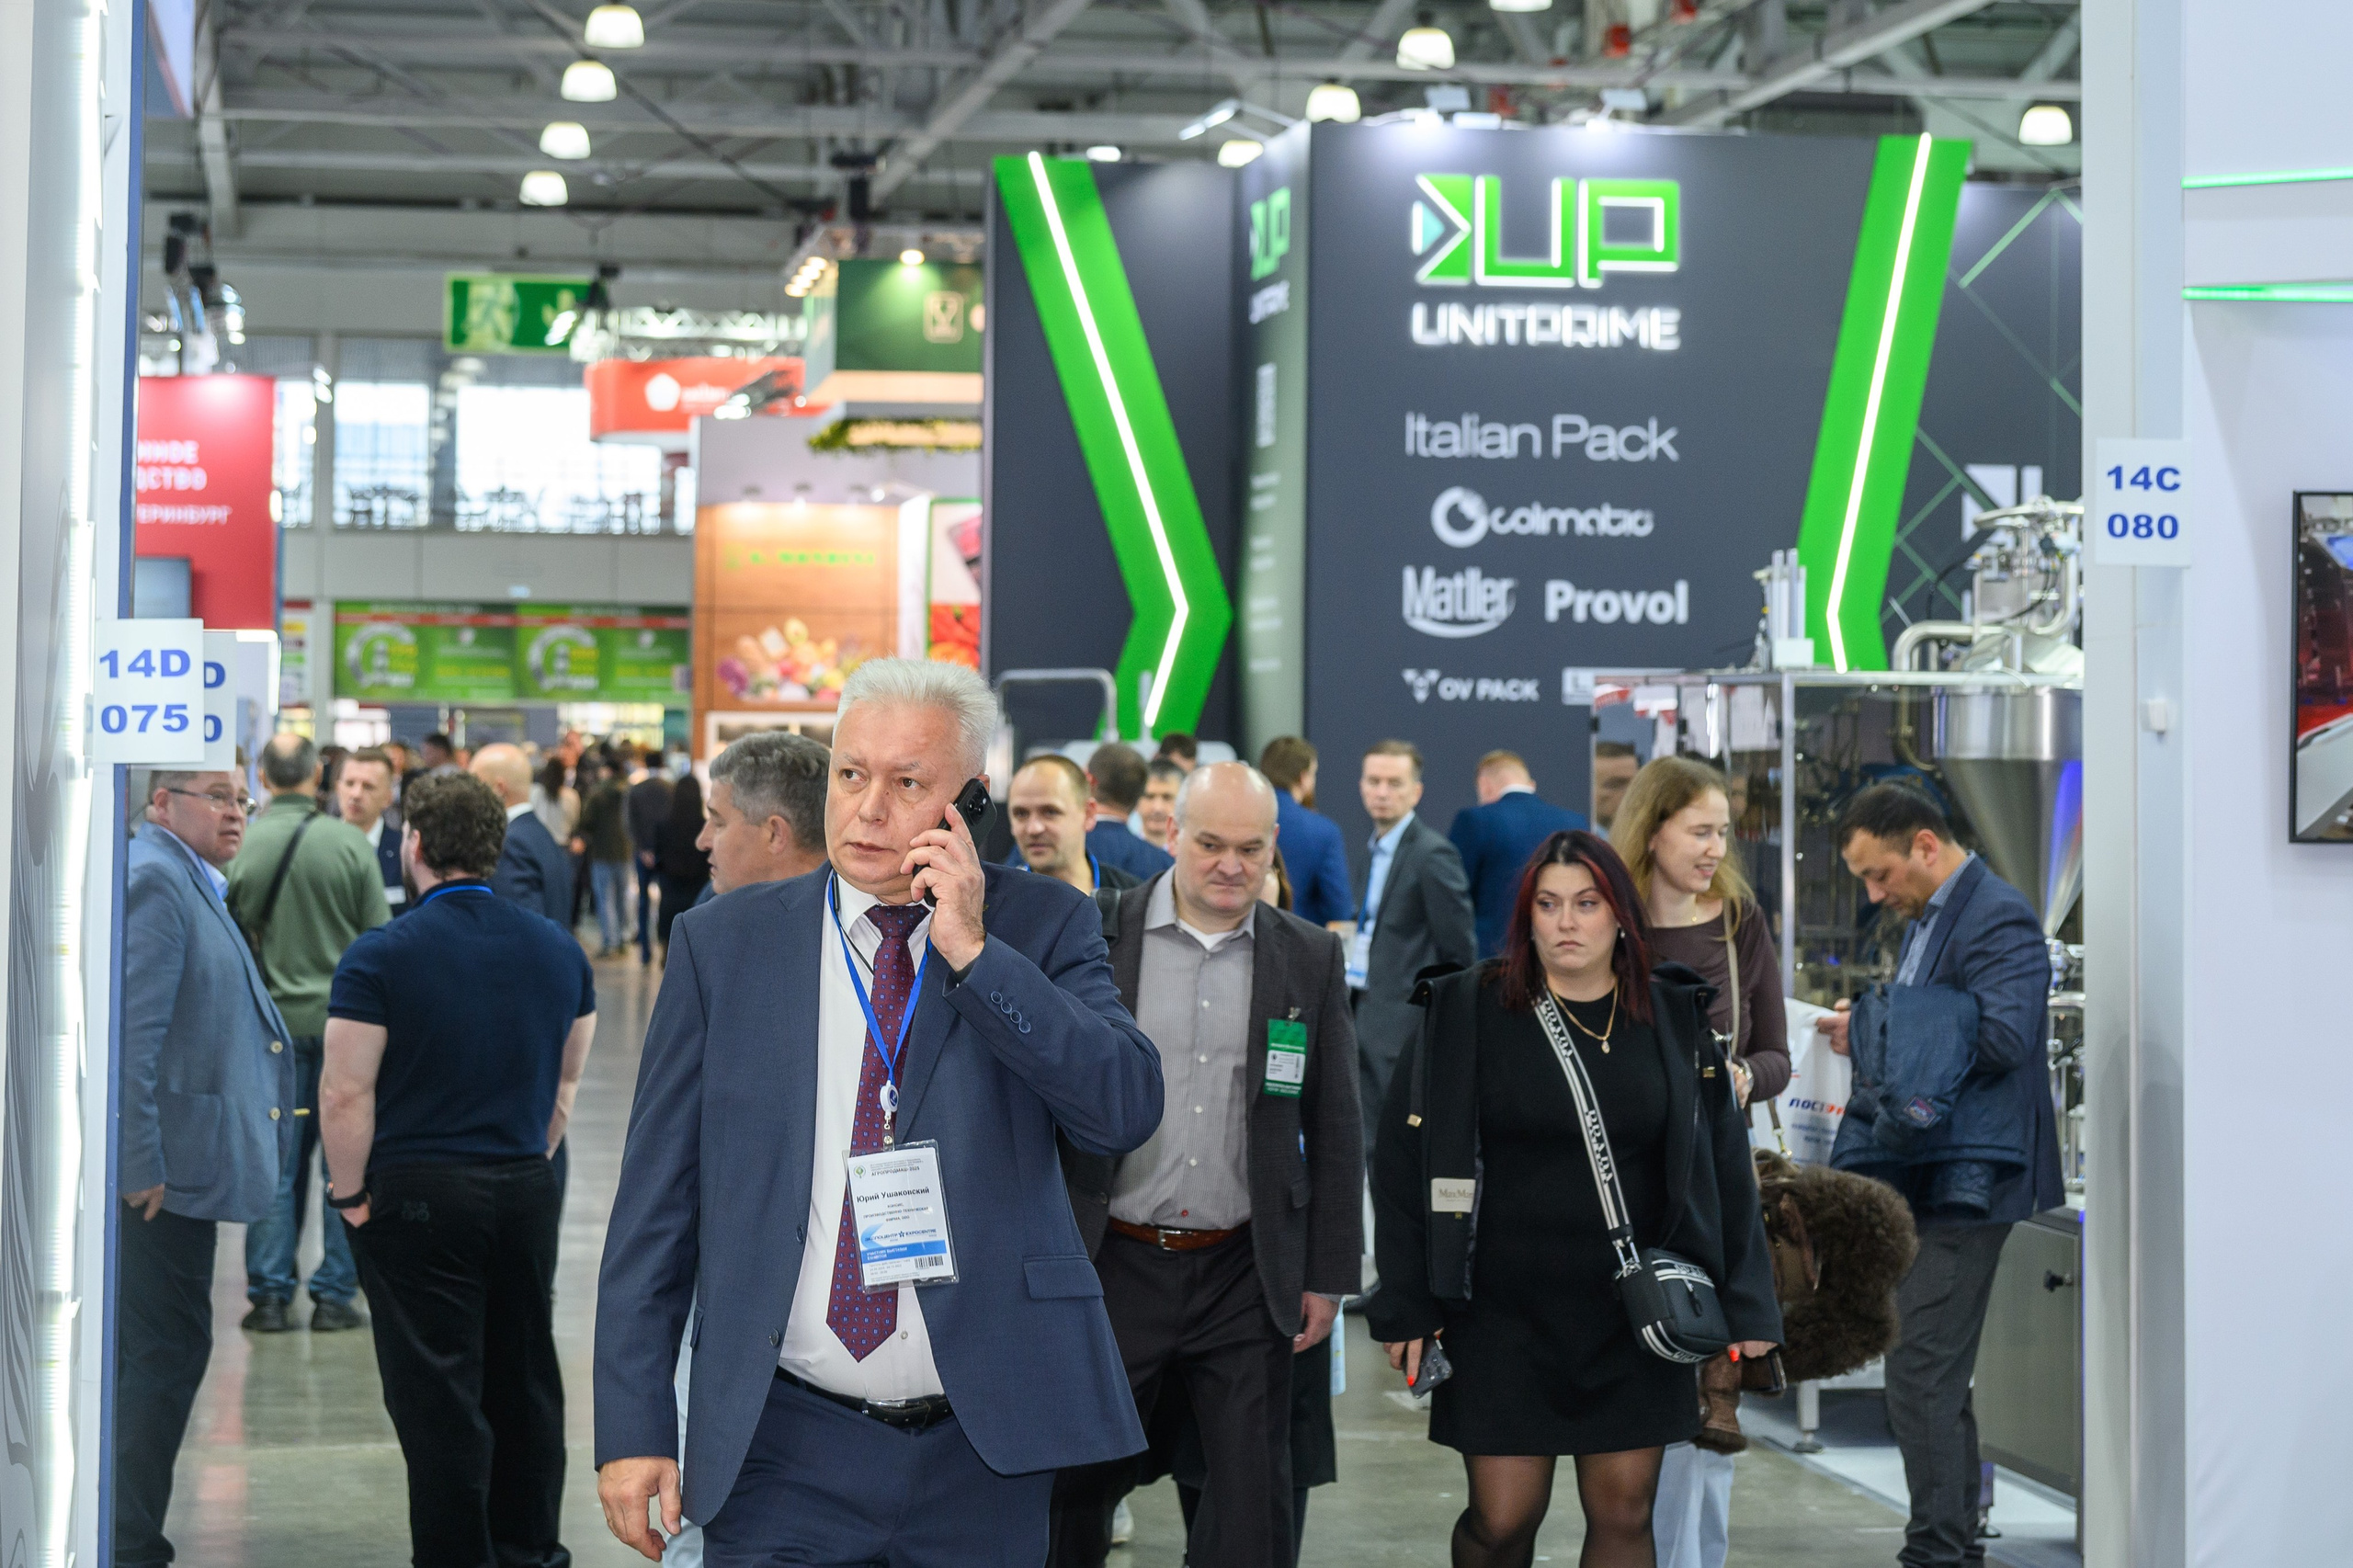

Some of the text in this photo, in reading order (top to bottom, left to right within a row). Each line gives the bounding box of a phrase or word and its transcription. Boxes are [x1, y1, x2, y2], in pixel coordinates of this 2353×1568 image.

[1413, 301, 1680, 350] UNITPRIME
[1404, 411, 1680, 461] Italian Pack
[2107, 465, 2181, 492] 14C
[2108, 514, 2179, 540] 080
[1544, 579, 1689, 624] Provol
[99, 649, 191, 678] 14D
[1475, 678, 1540, 701] PACK
[100, 704, 189, 733] 075
[1585, 1109, 1613, 1184] PRADA
[857, 1187, 930, 1203] Юрий Ушаковский
